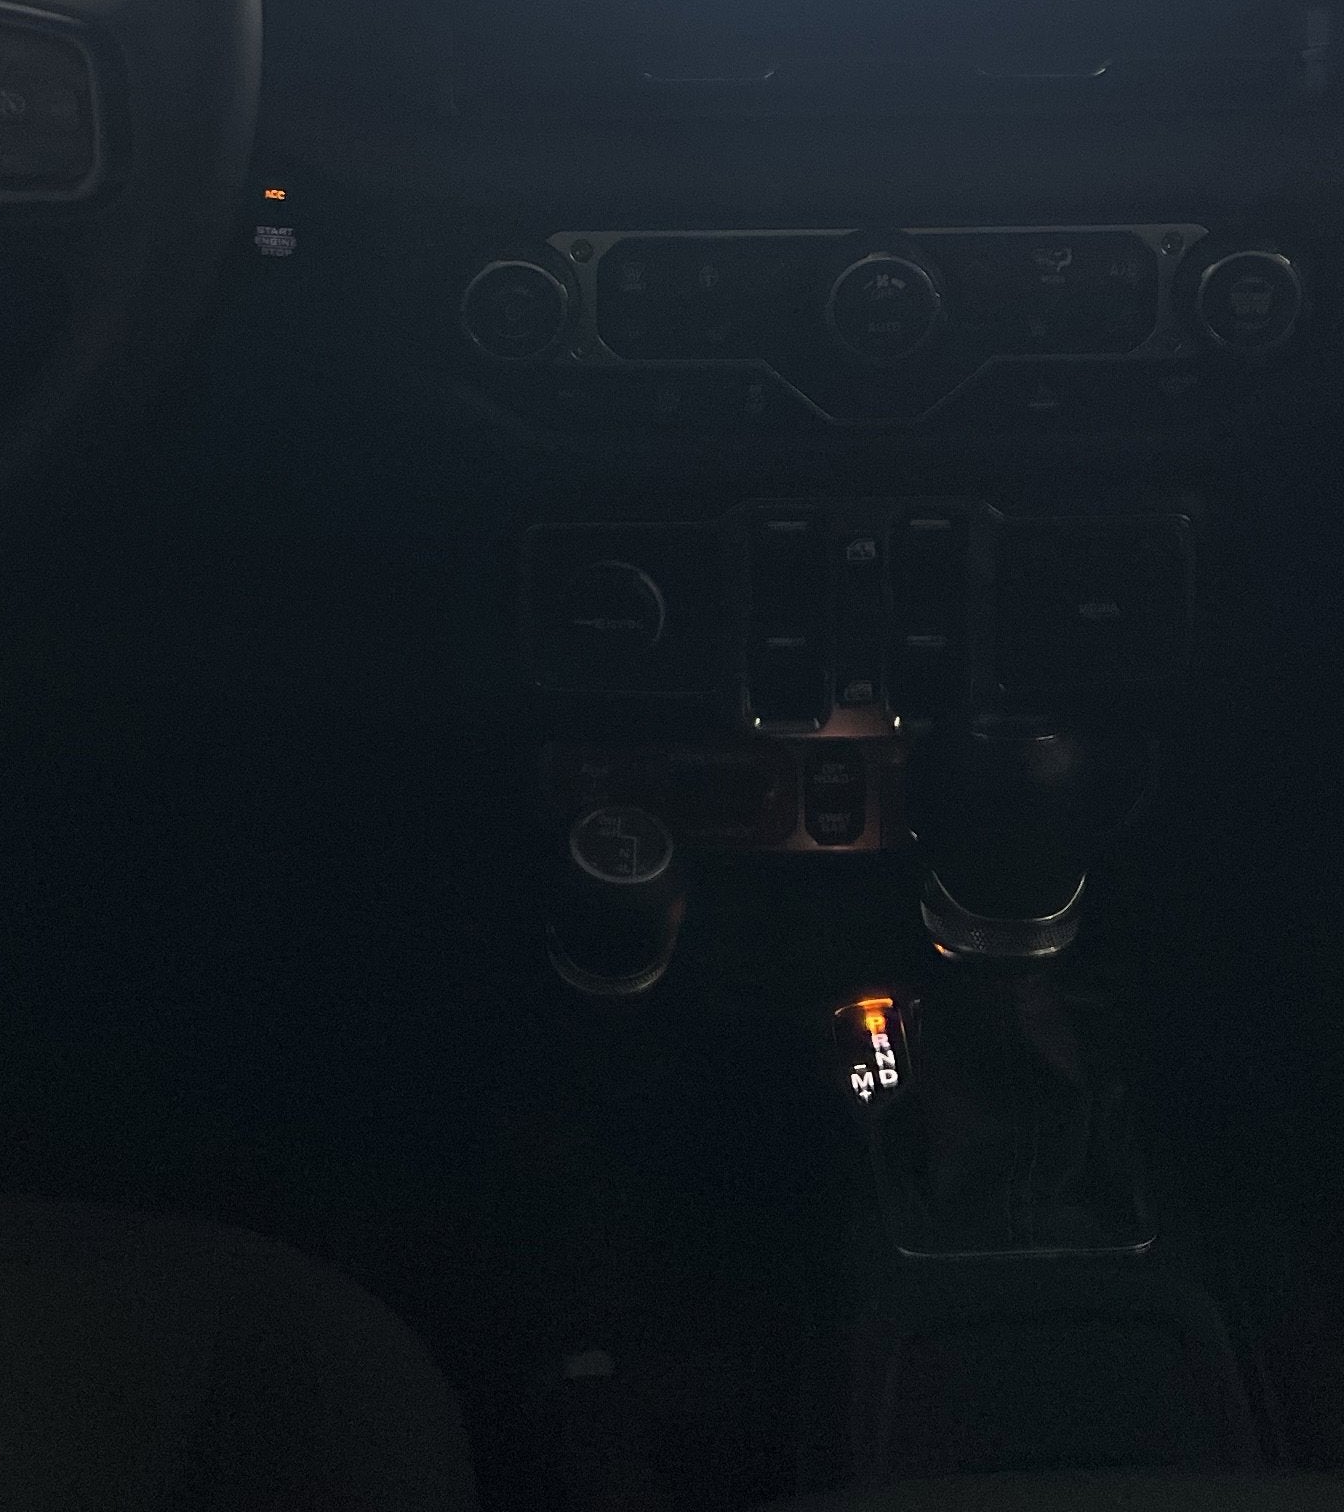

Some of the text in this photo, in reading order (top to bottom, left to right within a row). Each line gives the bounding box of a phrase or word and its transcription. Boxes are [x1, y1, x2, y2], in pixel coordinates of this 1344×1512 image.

[256, 226, 294, 236] START
[865, 1016, 885, 1035] P
[872, 1034, 890, 1049] R
[875, 1050, 895, 1069] N
[851, 1072, 874, 1090] M
[879, 1069, 898, 1087] D
